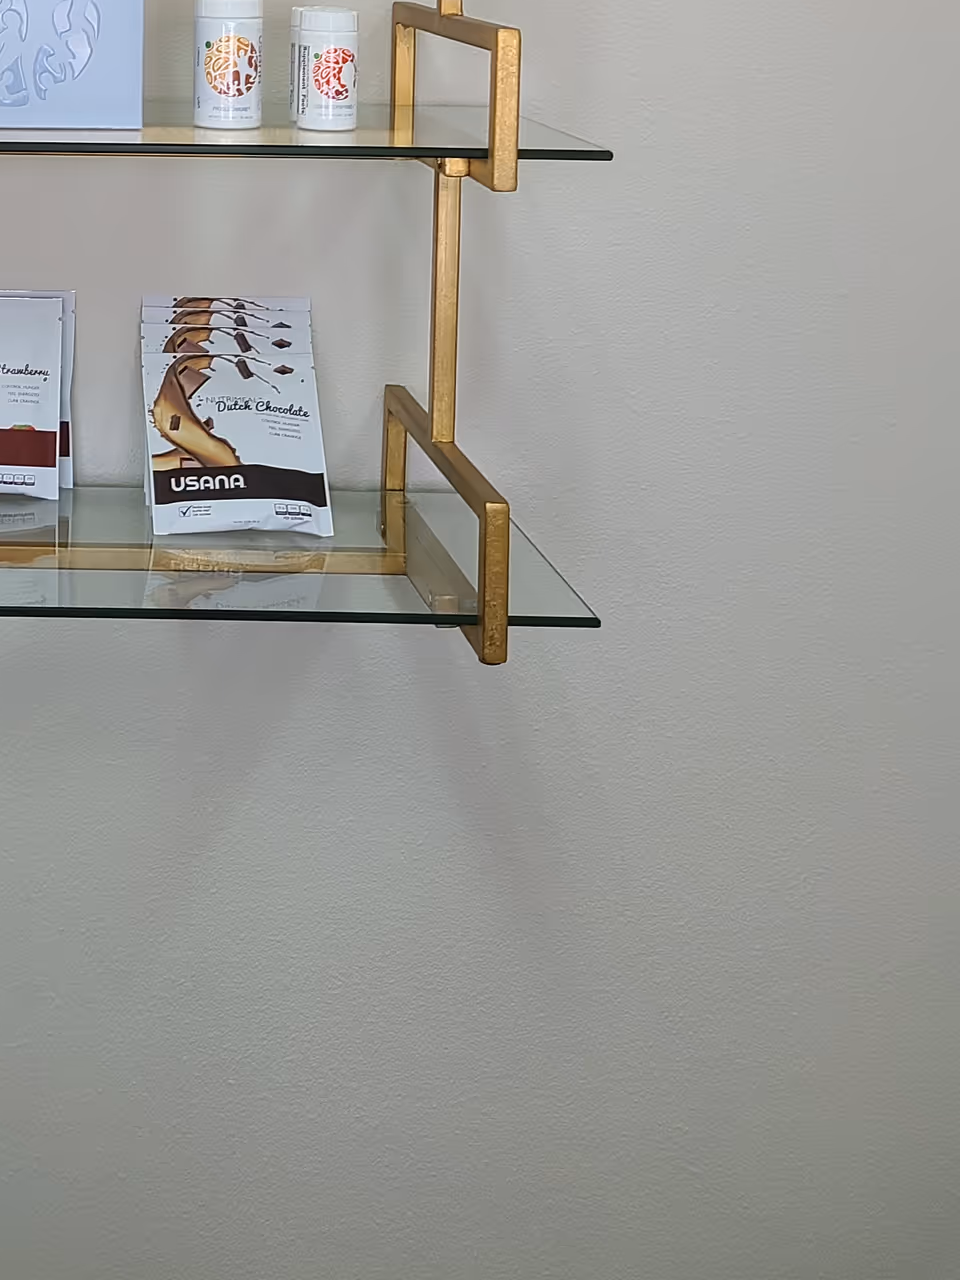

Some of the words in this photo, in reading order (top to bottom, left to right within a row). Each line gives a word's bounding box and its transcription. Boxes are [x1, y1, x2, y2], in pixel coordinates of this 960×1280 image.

[215, 400, 253, 413] Dutch
[255, 400, 311, 418] Chocolate
[170, 473, 245, 492] USANA
